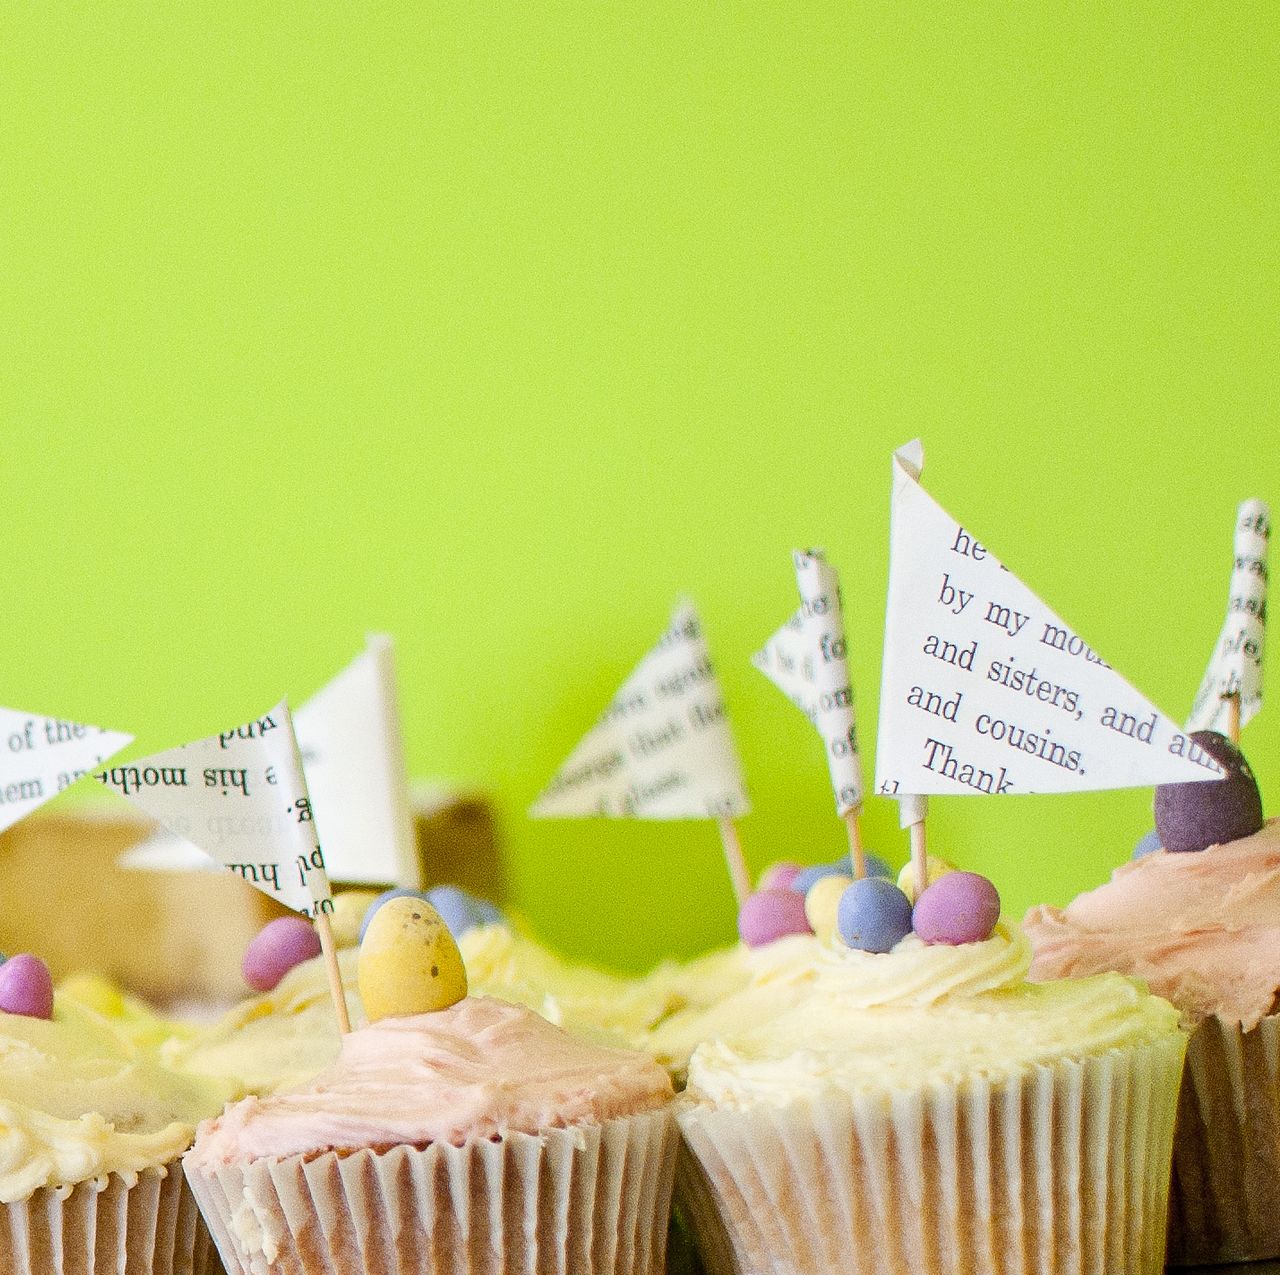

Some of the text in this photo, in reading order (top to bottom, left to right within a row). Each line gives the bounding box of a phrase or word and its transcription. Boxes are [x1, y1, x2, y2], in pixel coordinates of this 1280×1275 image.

[938, 573, 974, 615] by
[984, 601, 1031, 637] my
[923, 633, 979, 672] and
[987, 657, 1083, 721] sisters,
[1100, 705, 1158, 745] and
[8, 720, 35, 750] of
[44, 718, 86, 745] the
[907, 685, 1086, 776] and cousins.
[203, 767, 250, 796] his
[922, 737, 1014, 794] Thank
